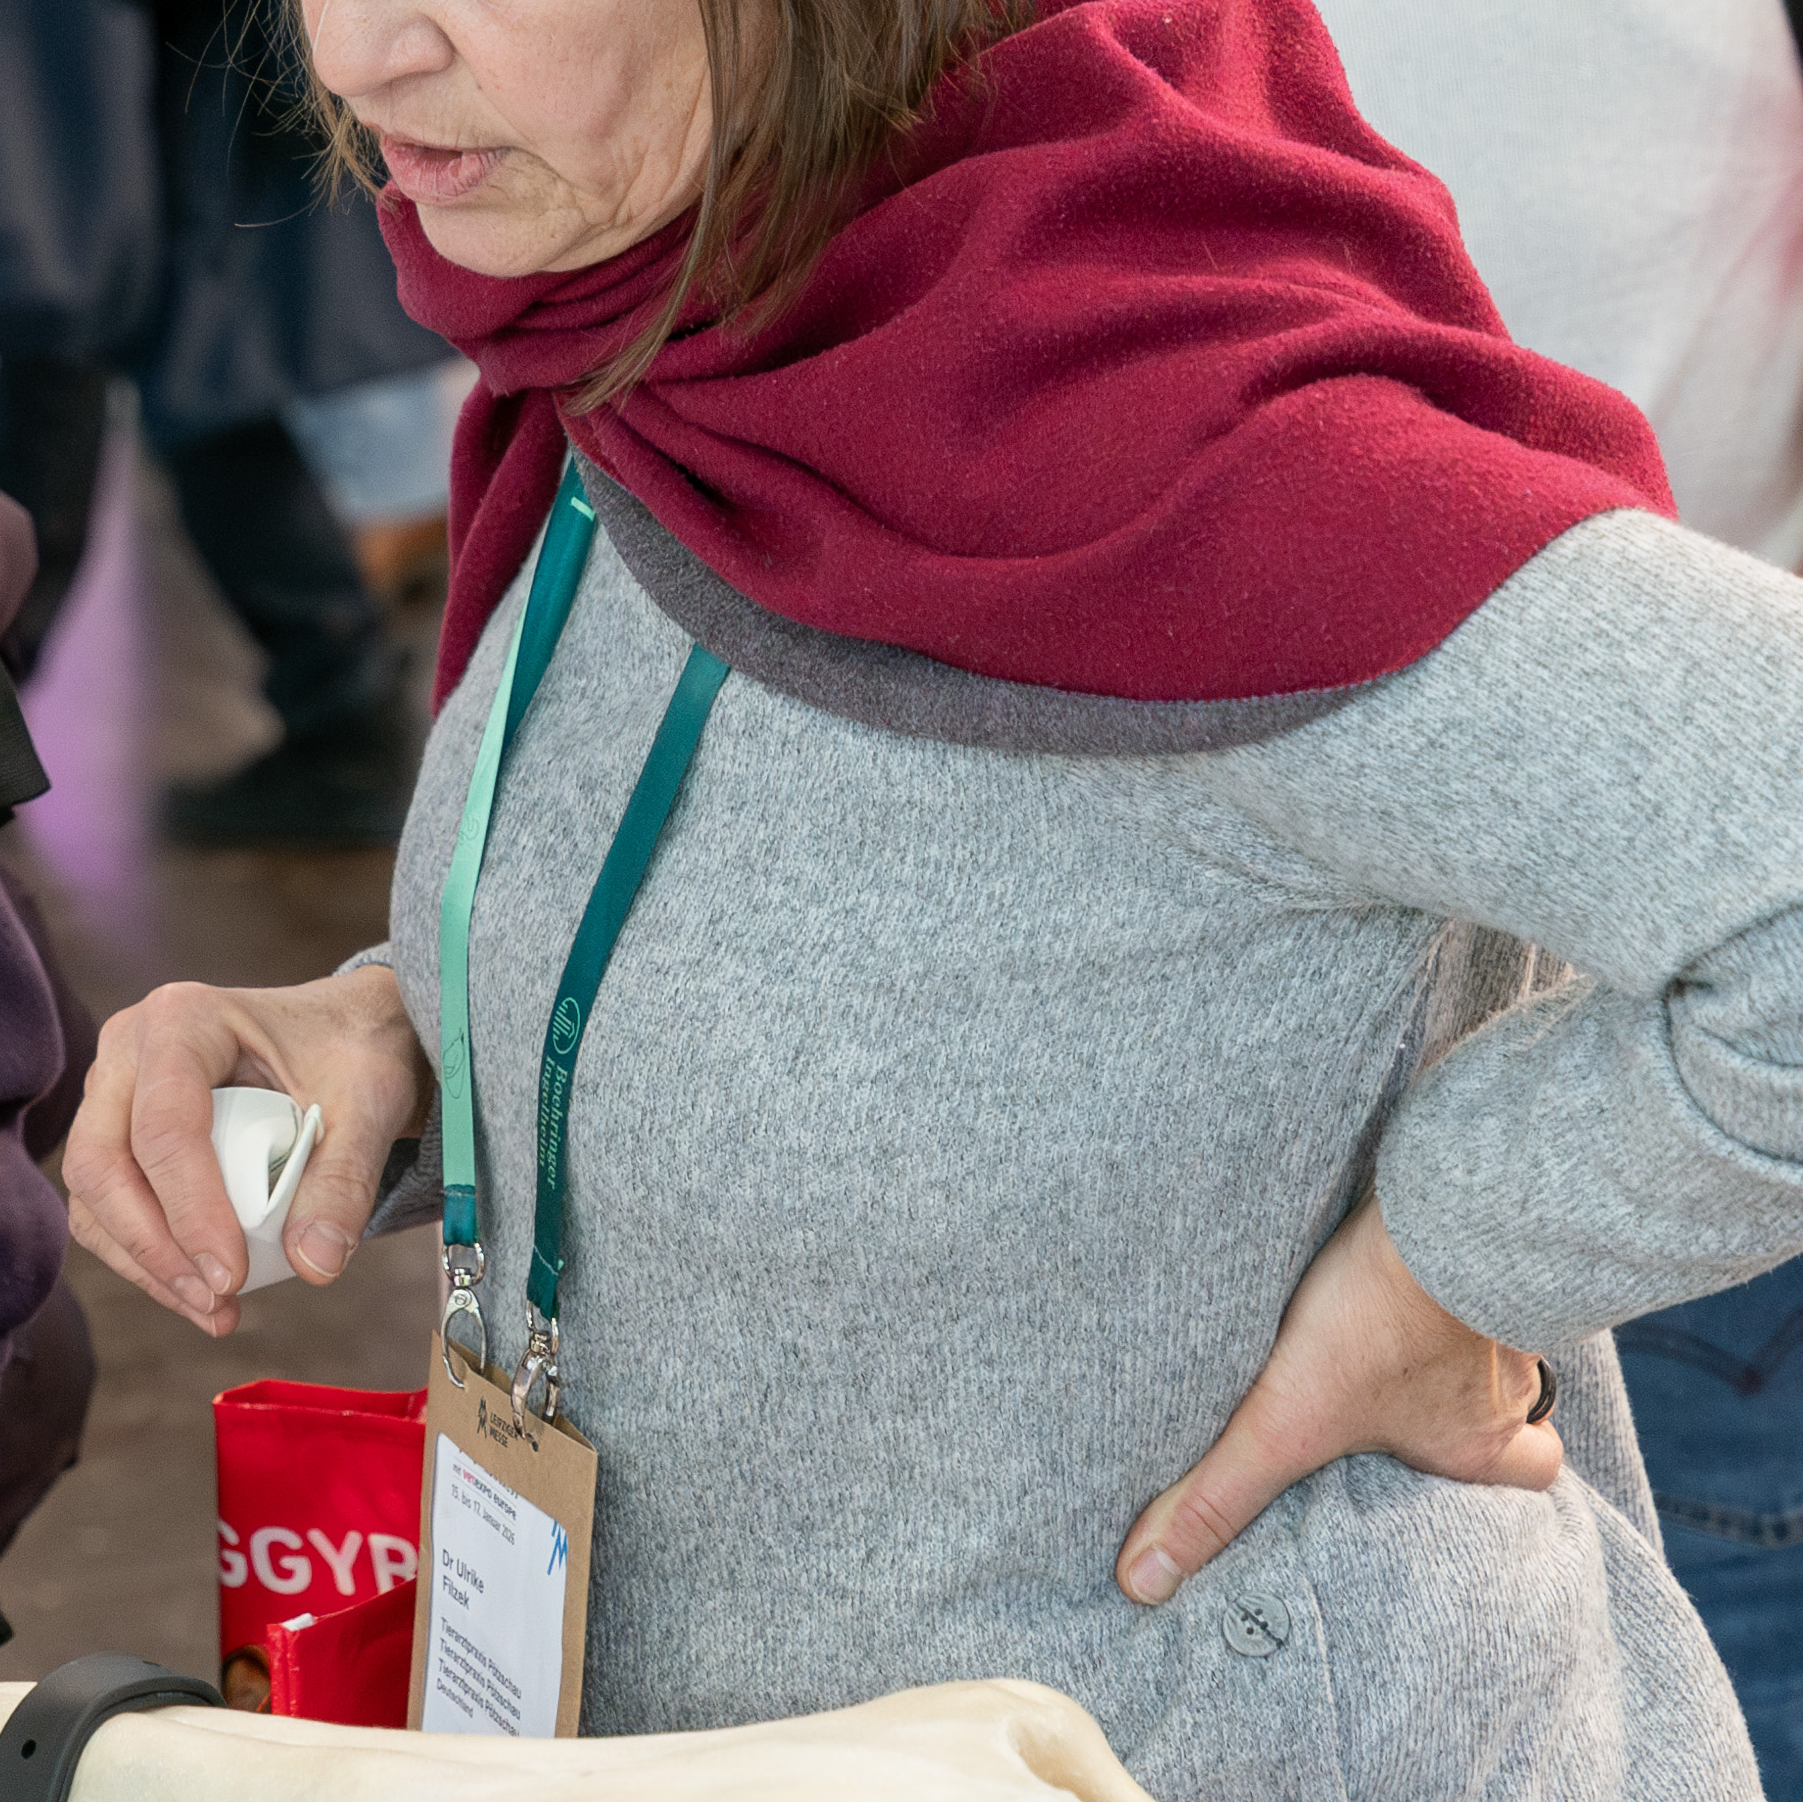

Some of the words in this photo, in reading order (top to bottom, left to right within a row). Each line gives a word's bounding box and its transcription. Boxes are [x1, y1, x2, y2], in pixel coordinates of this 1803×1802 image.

[539, 1055, 555, 1167] Ingelheim
[547, 1065, 568, 1190] Boehringer
[442, 1549, 453, 1571] Dr
[456, 1558, 485, 1594] Ulrike
[442, 1575, 470, 1609] Filzek
